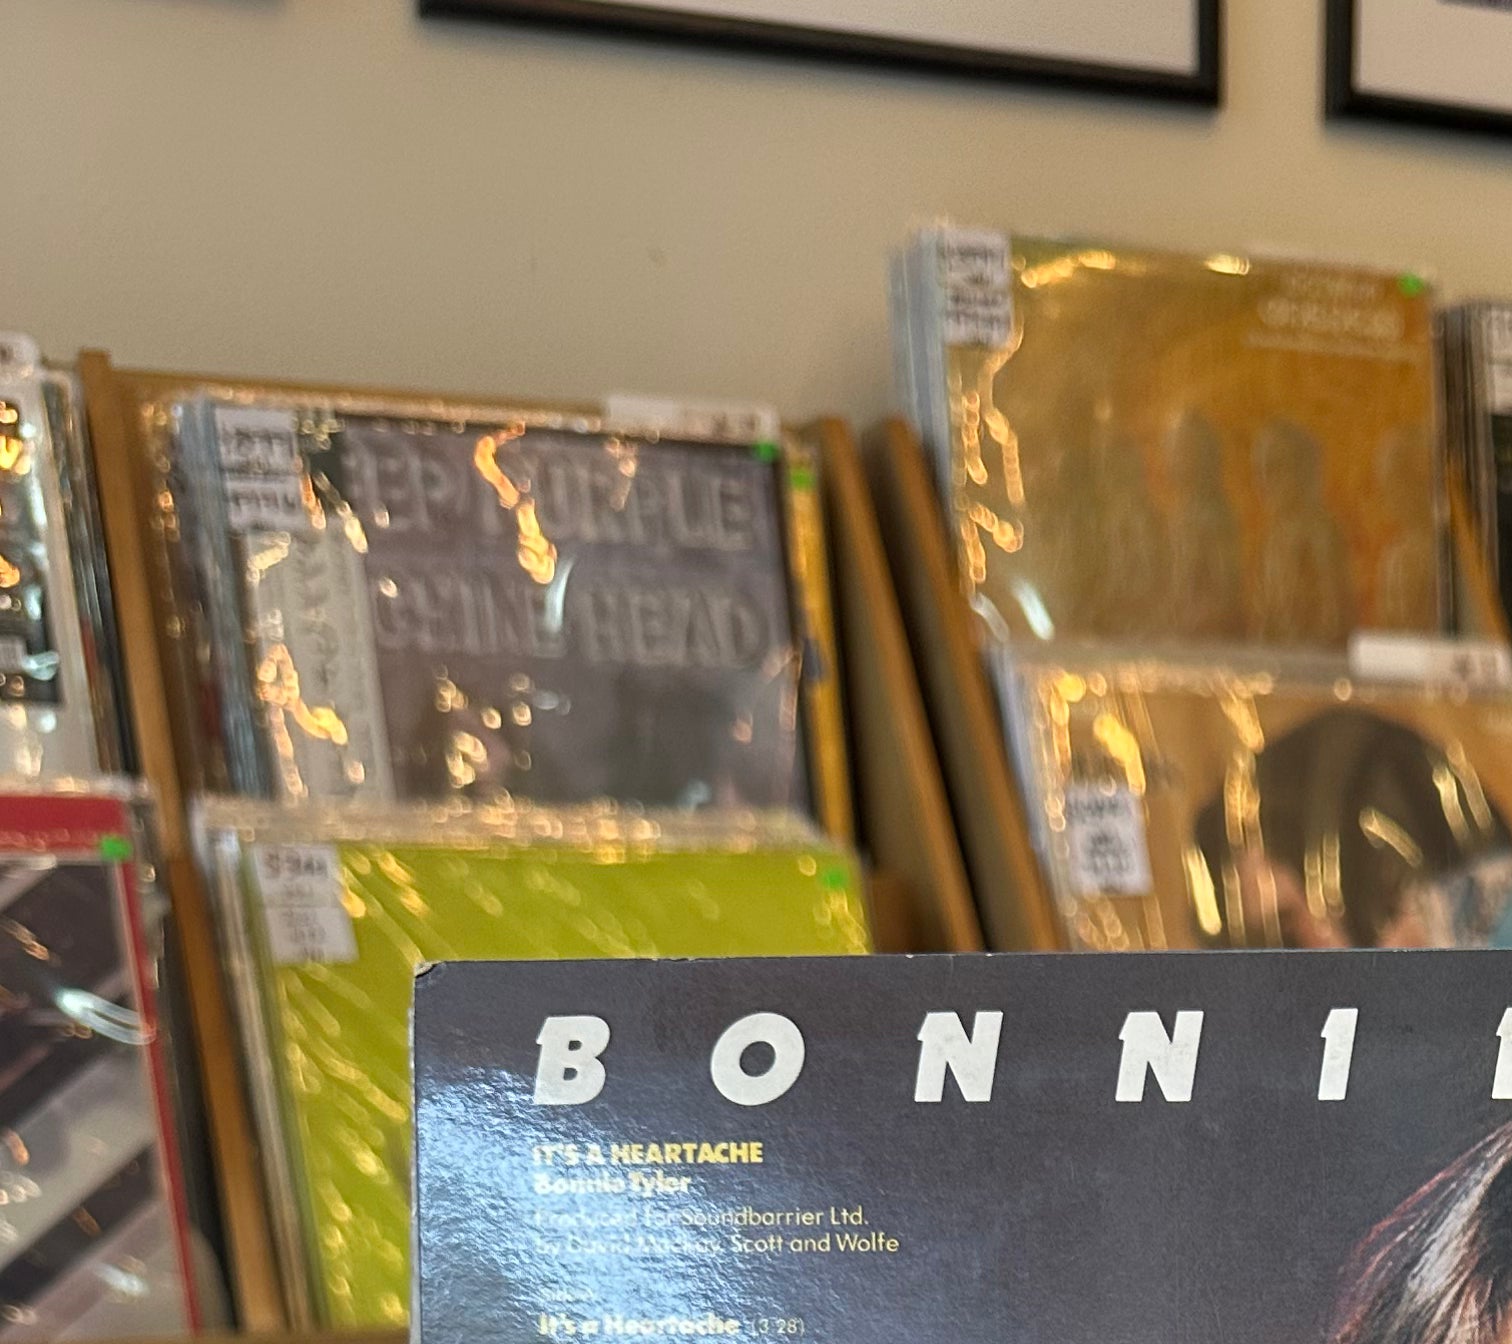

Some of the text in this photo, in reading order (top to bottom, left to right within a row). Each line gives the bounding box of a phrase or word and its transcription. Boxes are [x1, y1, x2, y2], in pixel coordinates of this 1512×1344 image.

[533, 1141, 764, 1166] IT'S A HEARTACHE
[534, 1170, 692, 1198] Bonnie Tyler
[644, 1206, 677, 1226] for
[681, 1204, 826, 1227] Soundbarrier
[830, 1204, 869, 1226] Ltd.
[730, 1233, 784, 1254] Scott
[790, 1233, 830, 1253] and
[834, 1231, 900, 1253] Wolfe
[582, 1318, 600, 1335] a
[602, 1311, 741, 1336] Heartache
[752, 1318, 805, 1338] (328)
